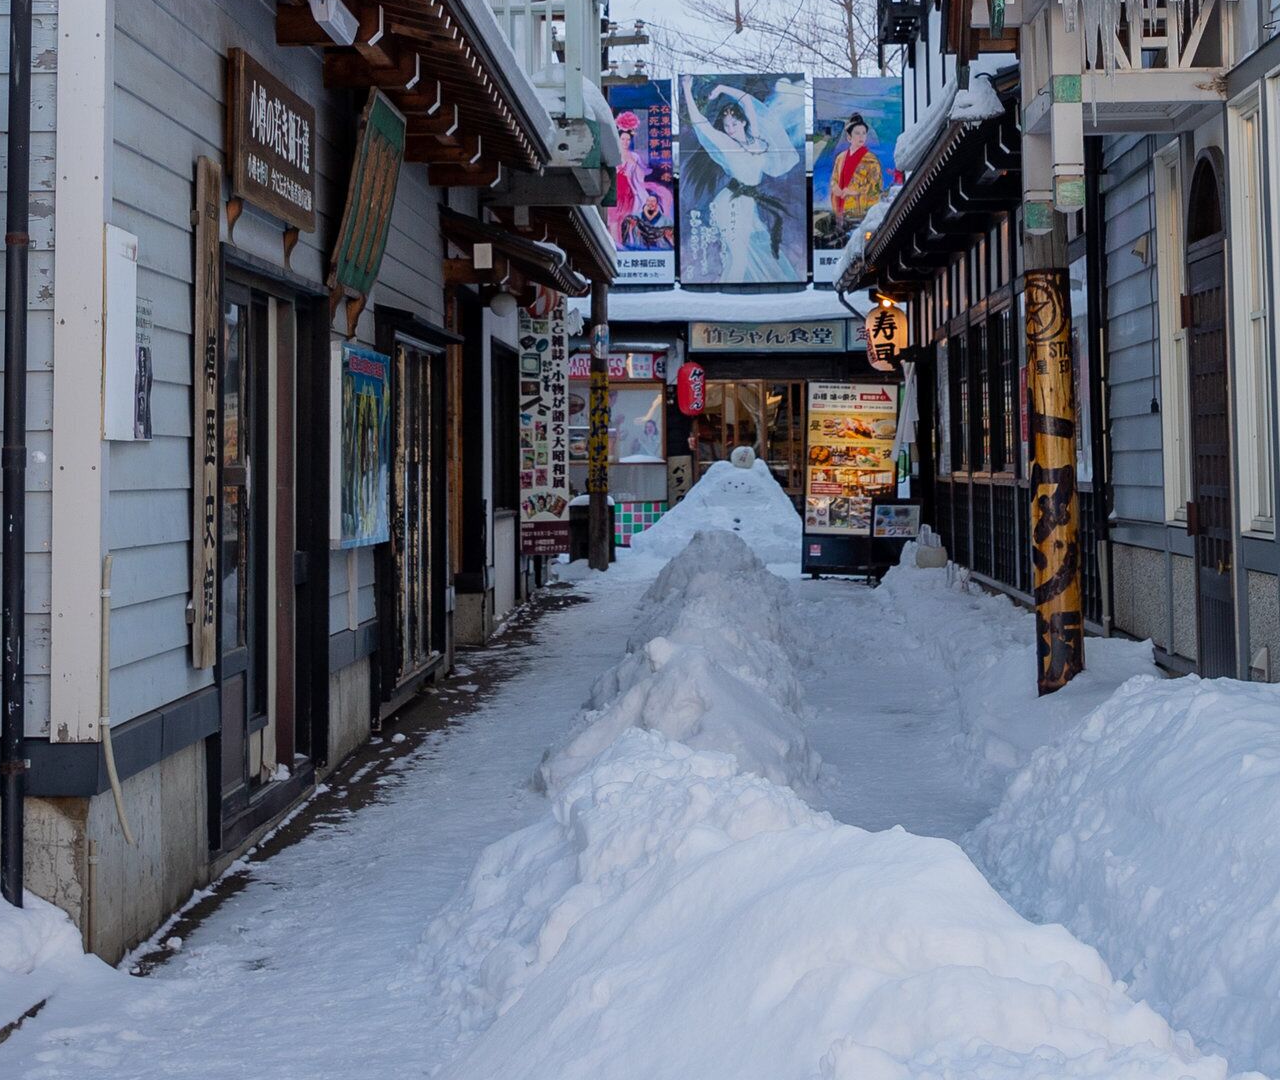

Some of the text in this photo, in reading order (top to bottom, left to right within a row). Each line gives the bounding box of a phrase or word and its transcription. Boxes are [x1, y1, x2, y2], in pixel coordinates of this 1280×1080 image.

[703, 325, 833, 347] 竹ちゃん食堂
[872, 310, 898, 362] 寿司
